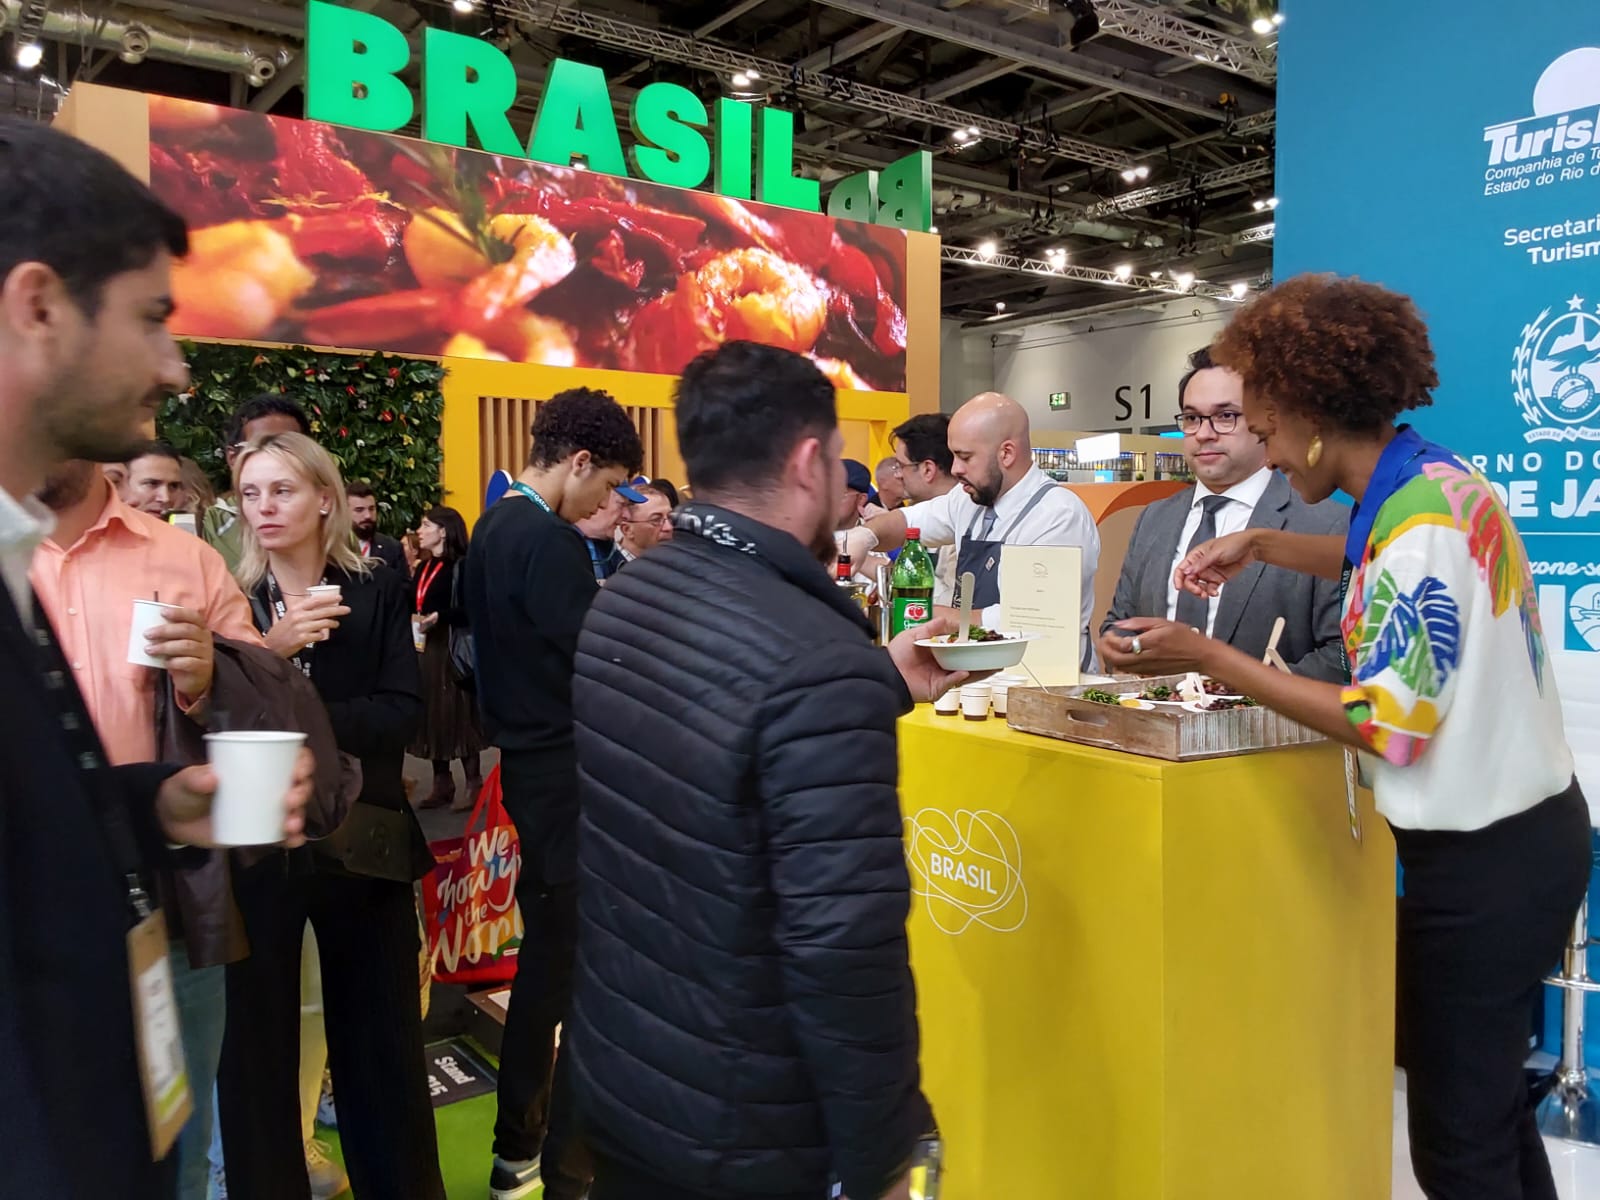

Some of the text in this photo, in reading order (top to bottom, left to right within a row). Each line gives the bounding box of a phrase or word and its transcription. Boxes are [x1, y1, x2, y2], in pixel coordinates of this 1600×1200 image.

[304, 0, 821, 212] BRASIL
[1484, 107, 1600, 166] Turis
[1484, 177, 1530, 195] Estado
[1536, 172, 1554, 186] do
[1560, 166, 1584, 181] Rio
[1485, 156, 1562, 181] Companhia
[1566, 151, 1585, 165] de
[1504, 213, 1600, 246] Secretari
[1115, 384, 1151, 421] S1
[469, 826, 510, 867] We
[930, 852, 998, 895] BRASIL
[464, 901, 489, 927] the
[434, 1056, 476, 1085] Stand
